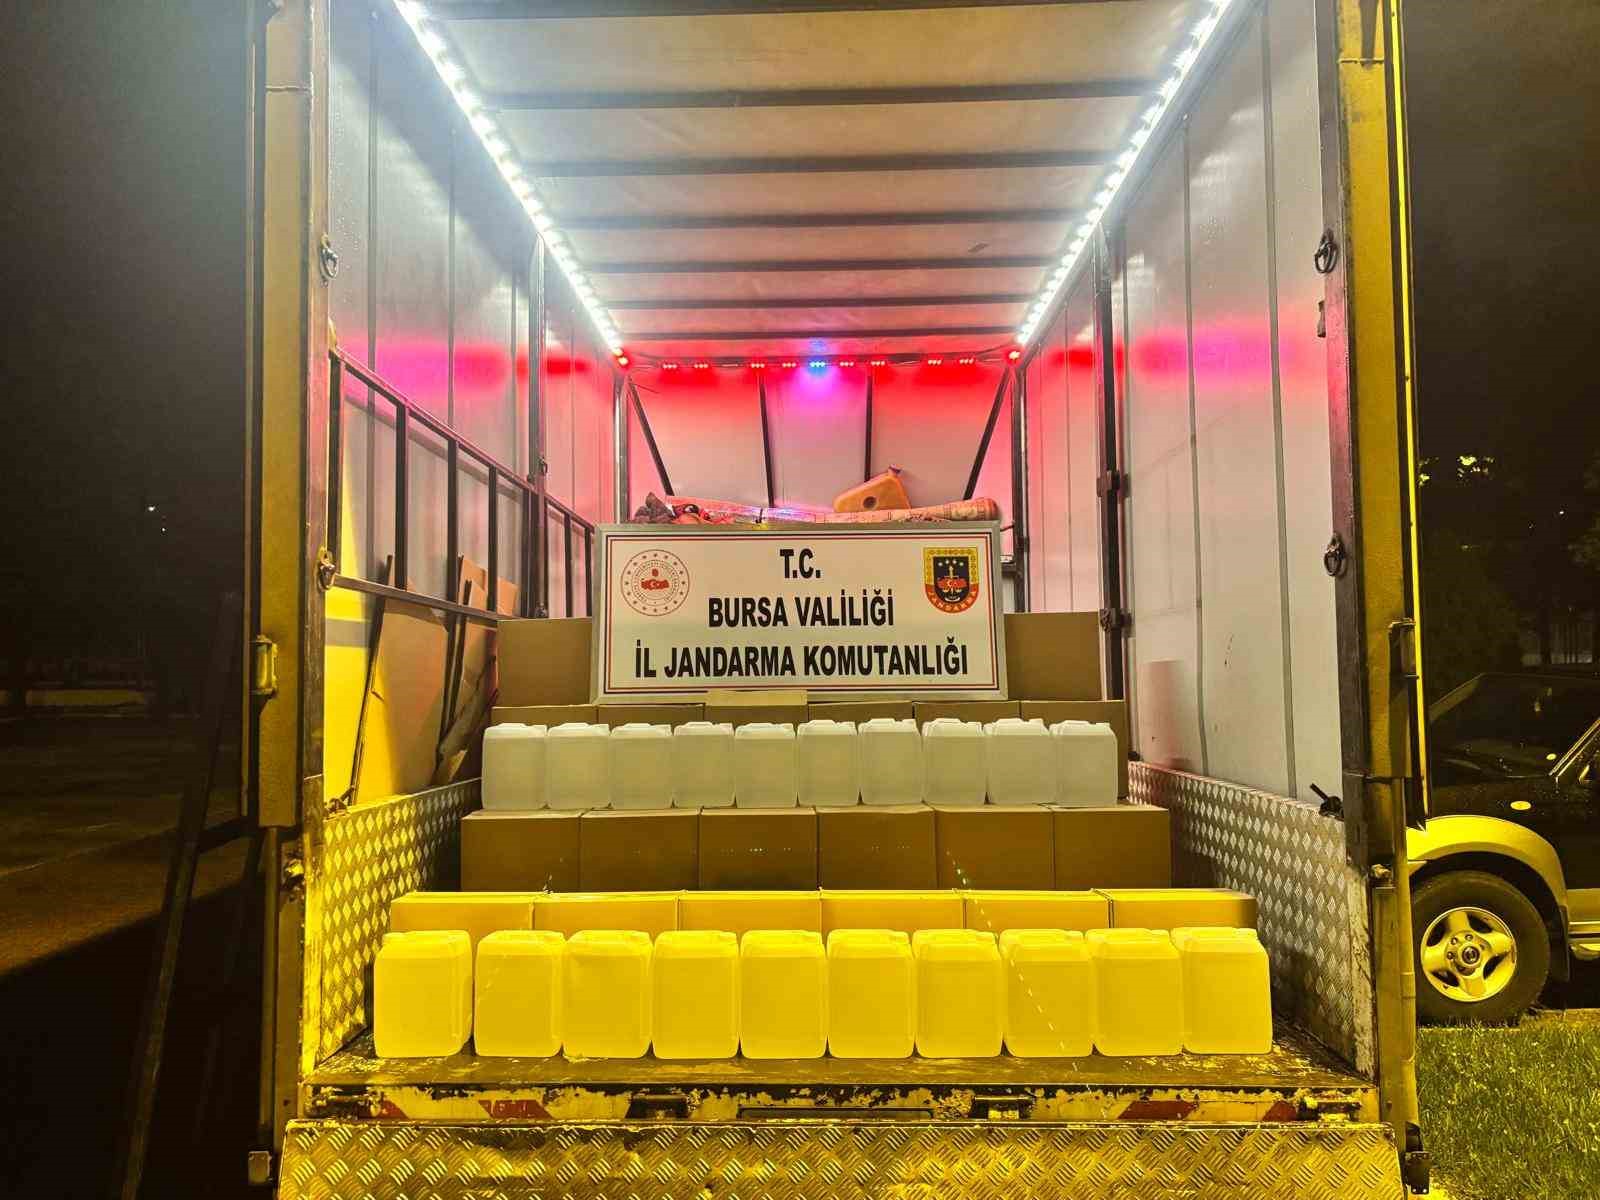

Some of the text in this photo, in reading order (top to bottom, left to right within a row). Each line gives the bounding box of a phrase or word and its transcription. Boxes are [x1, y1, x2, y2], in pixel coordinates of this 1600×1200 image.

[780, 549, 821, 579] T.C.
[709, 588, 894, 627] BURSA VALİLİĞİ
[636, 636, 968, 678] İL JANDARMA KOMUTANLIĞI
